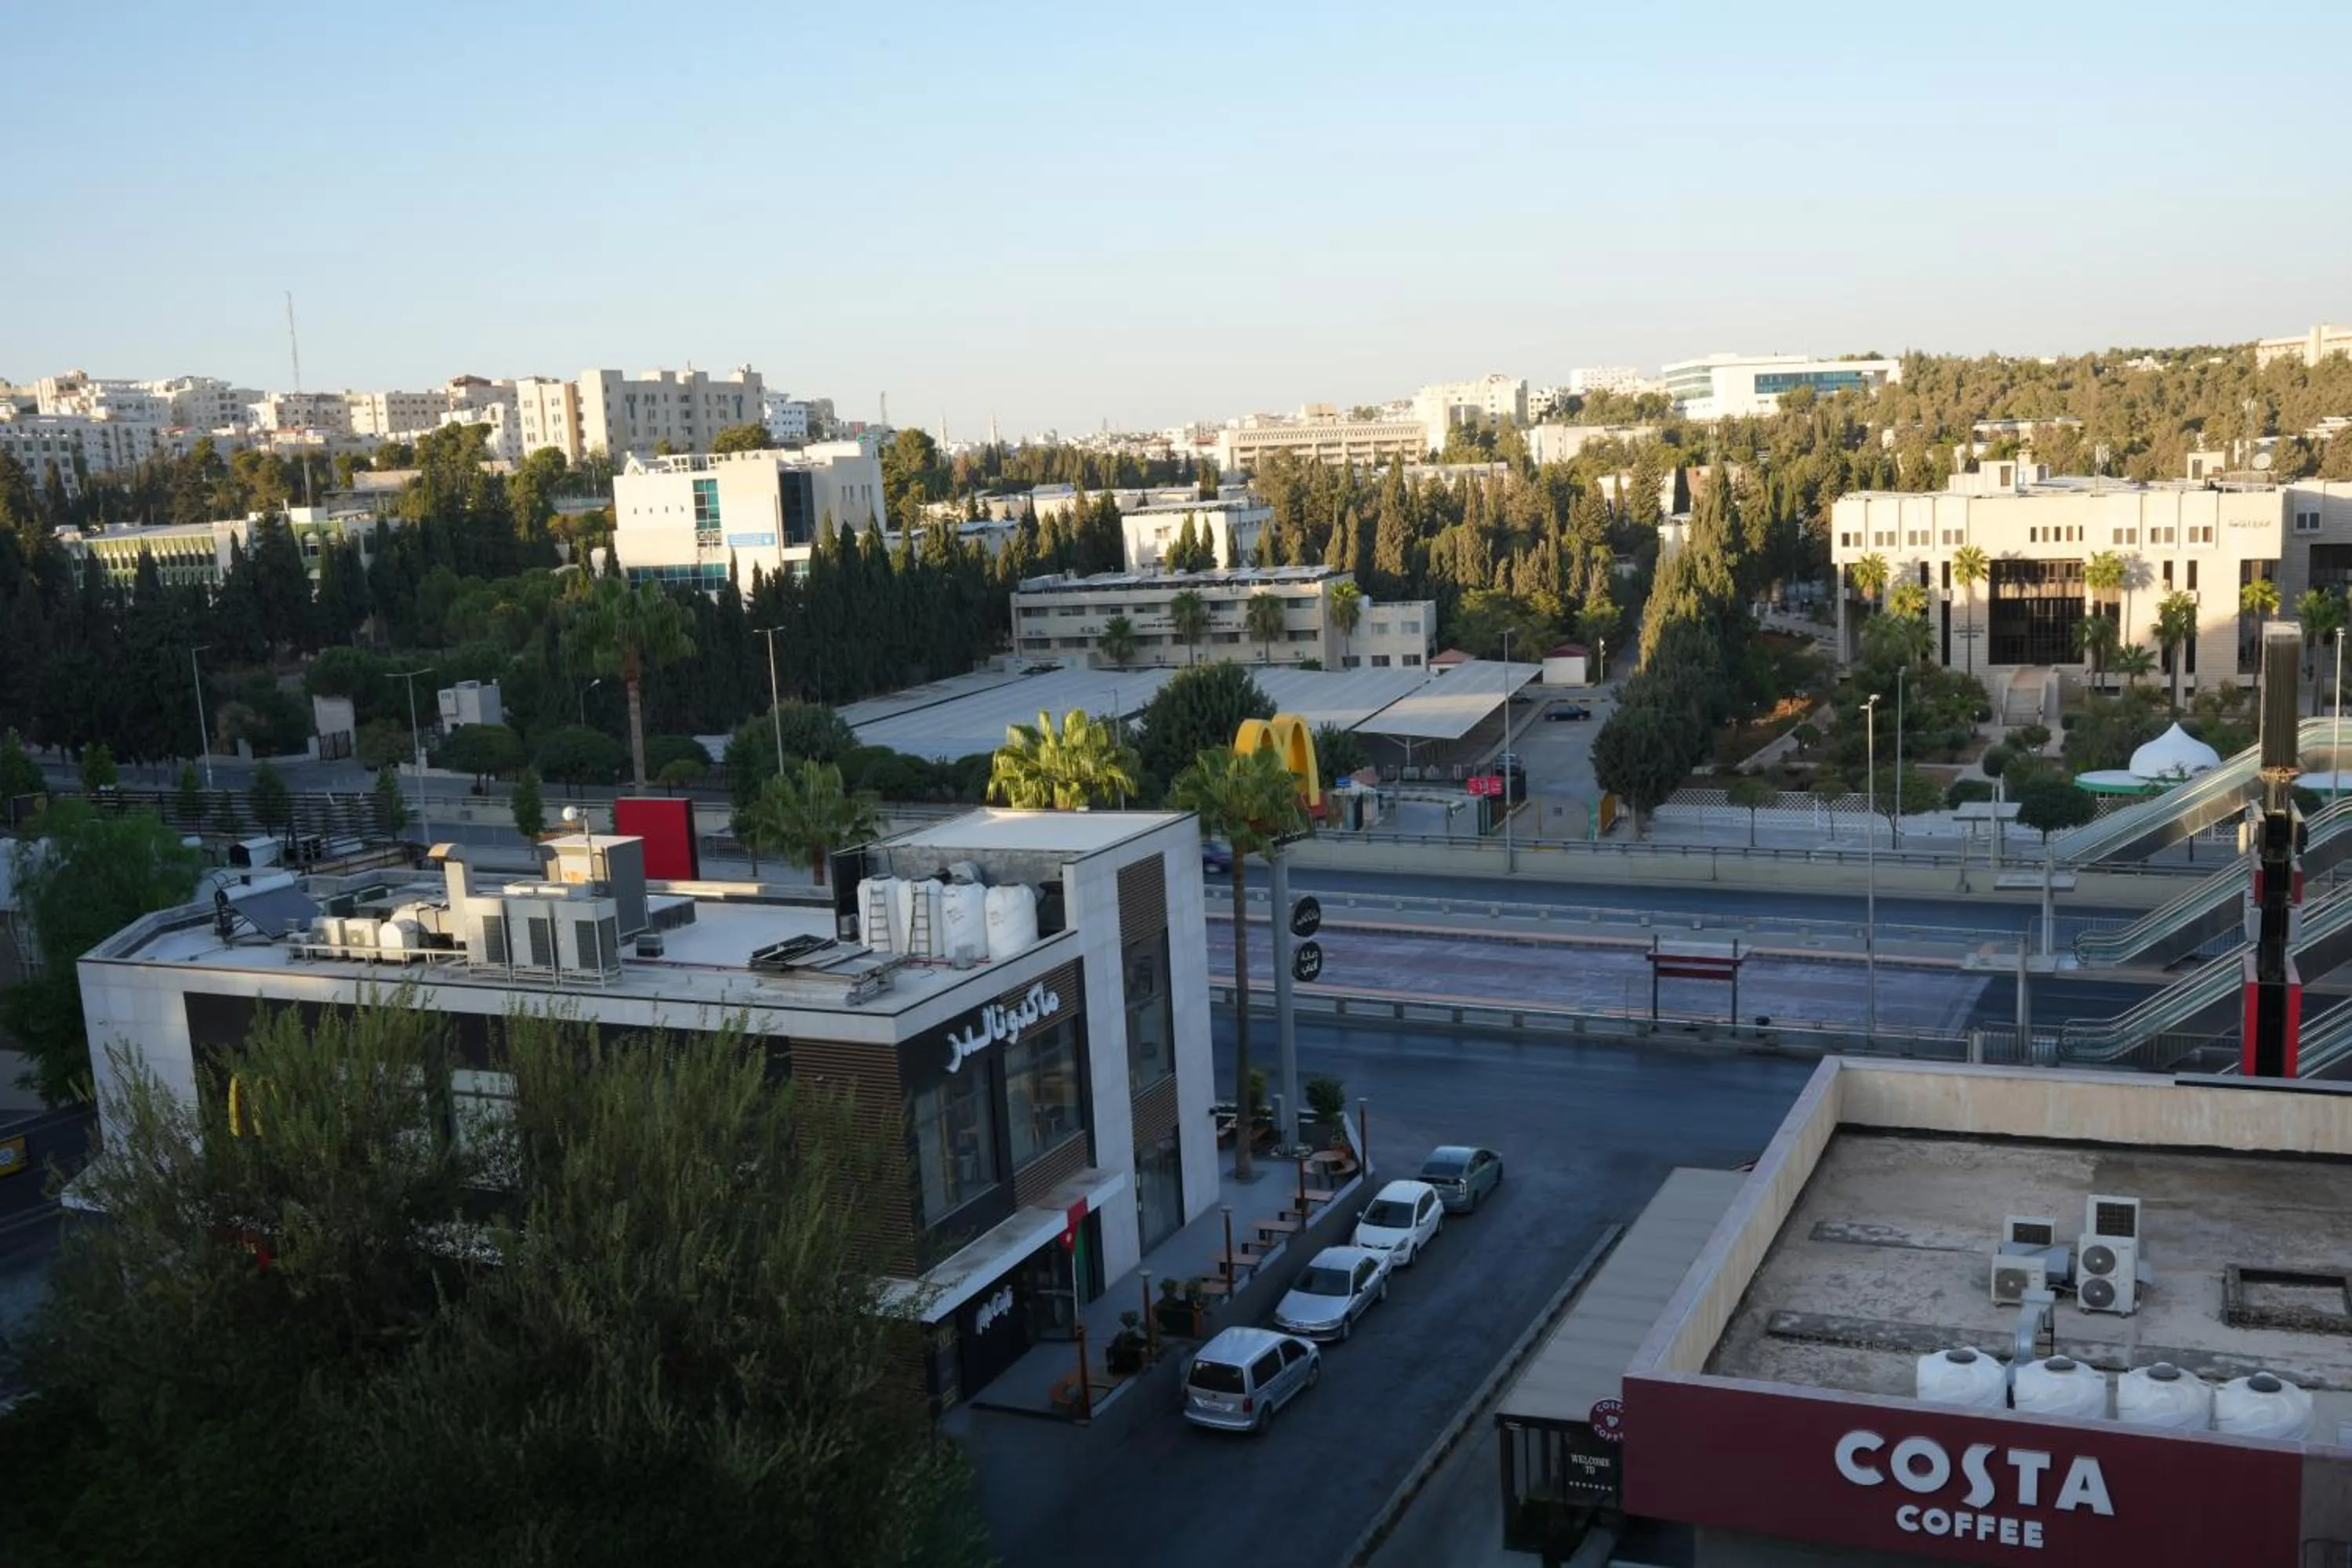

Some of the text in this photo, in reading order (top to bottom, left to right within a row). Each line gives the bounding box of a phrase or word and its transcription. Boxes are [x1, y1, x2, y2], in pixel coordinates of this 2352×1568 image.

[946, 982, 1059, 1074] ماكدونالدز
[1570, 1454, 1610, 1468] WELCOME
[1585, 1465, 1595, 1475] TO
[1835, 1430, 2114, 1516] COSTA
[1895, 1504, 2044, 1548] COFFEE
